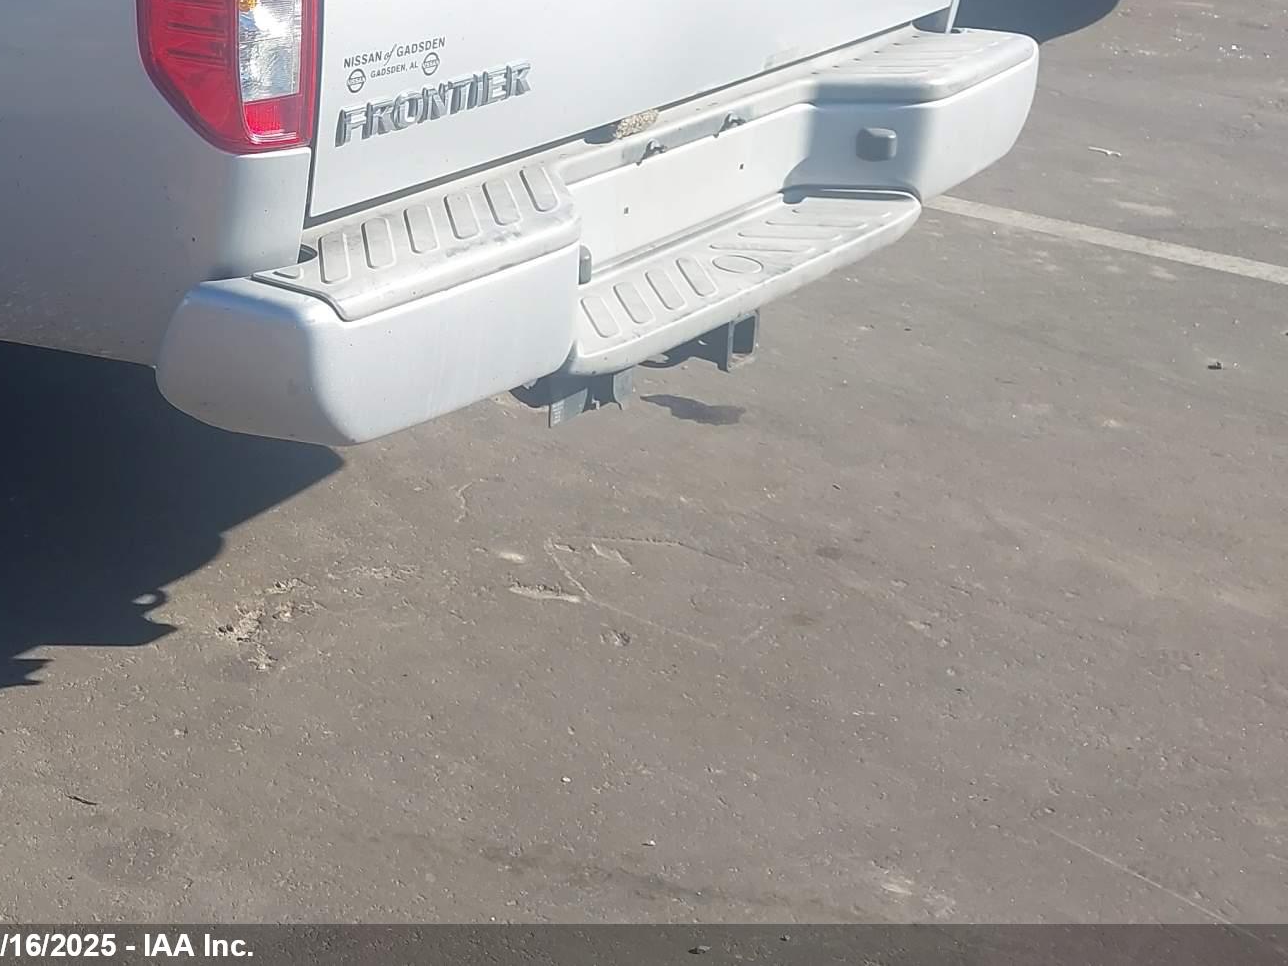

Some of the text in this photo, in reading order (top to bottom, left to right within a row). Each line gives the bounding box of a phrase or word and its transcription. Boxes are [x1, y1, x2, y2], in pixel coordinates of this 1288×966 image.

[343, 50, 383, 69] NISSAN
[383, 43, 398, 66] of
[396, 36, 446, 58] GADSDEN
[370, 63, 408, 79] GADSDEN,
[409, 60, 419, 70] AL
[335, 60, 532, 148] FRONTIER
